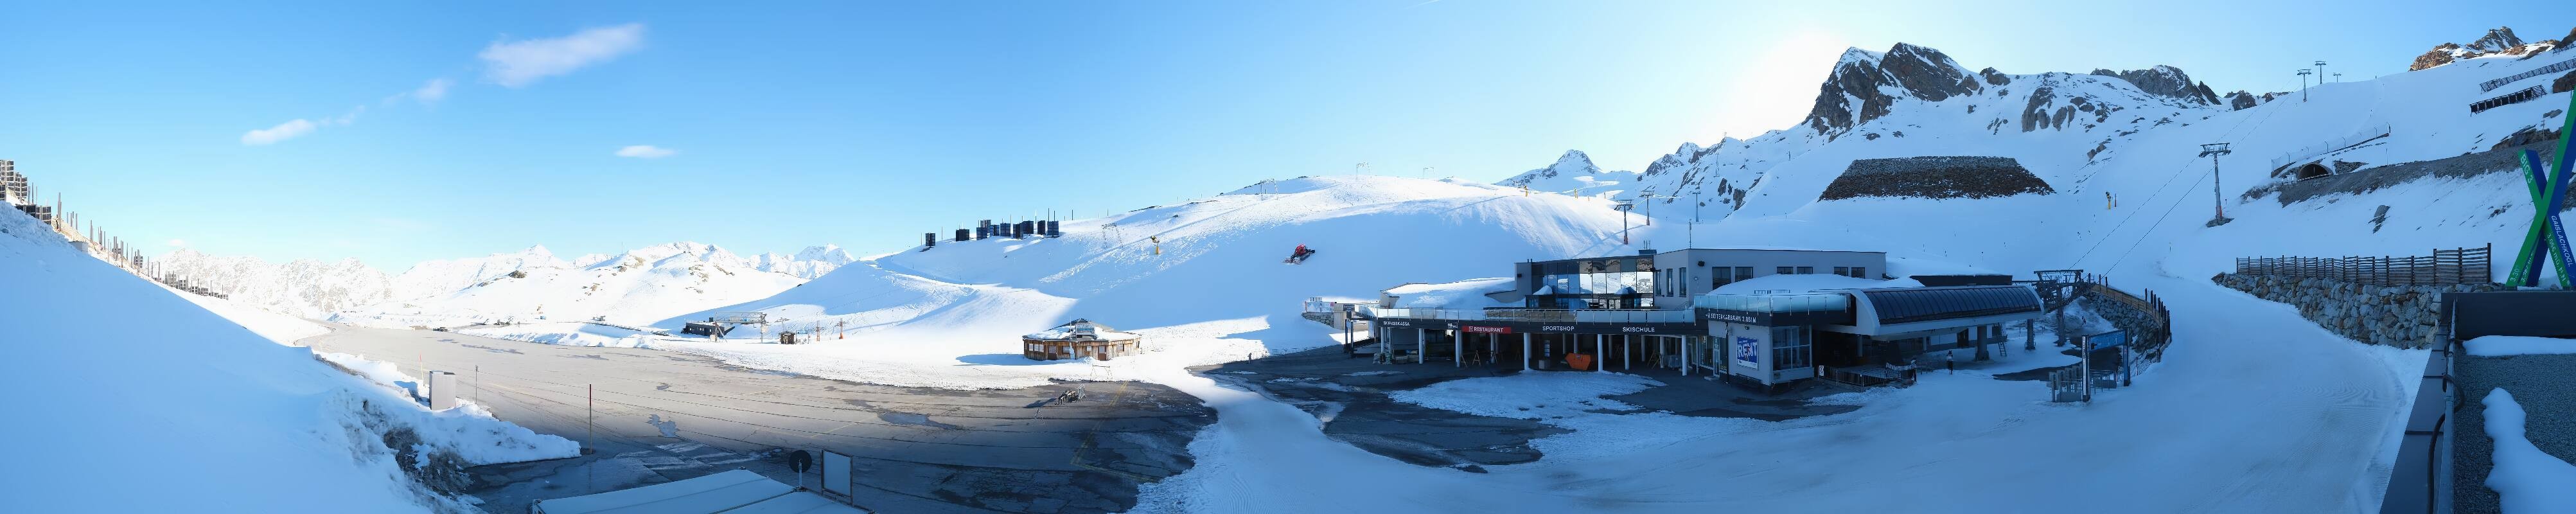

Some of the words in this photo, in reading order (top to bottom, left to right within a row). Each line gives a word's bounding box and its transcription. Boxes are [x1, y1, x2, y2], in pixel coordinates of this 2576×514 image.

[2520, 154, 2530, 175] BIG
[2527, 175, 2533, 184] 3
[2552, 215, 2573, 267] GAISLACHKOGL
